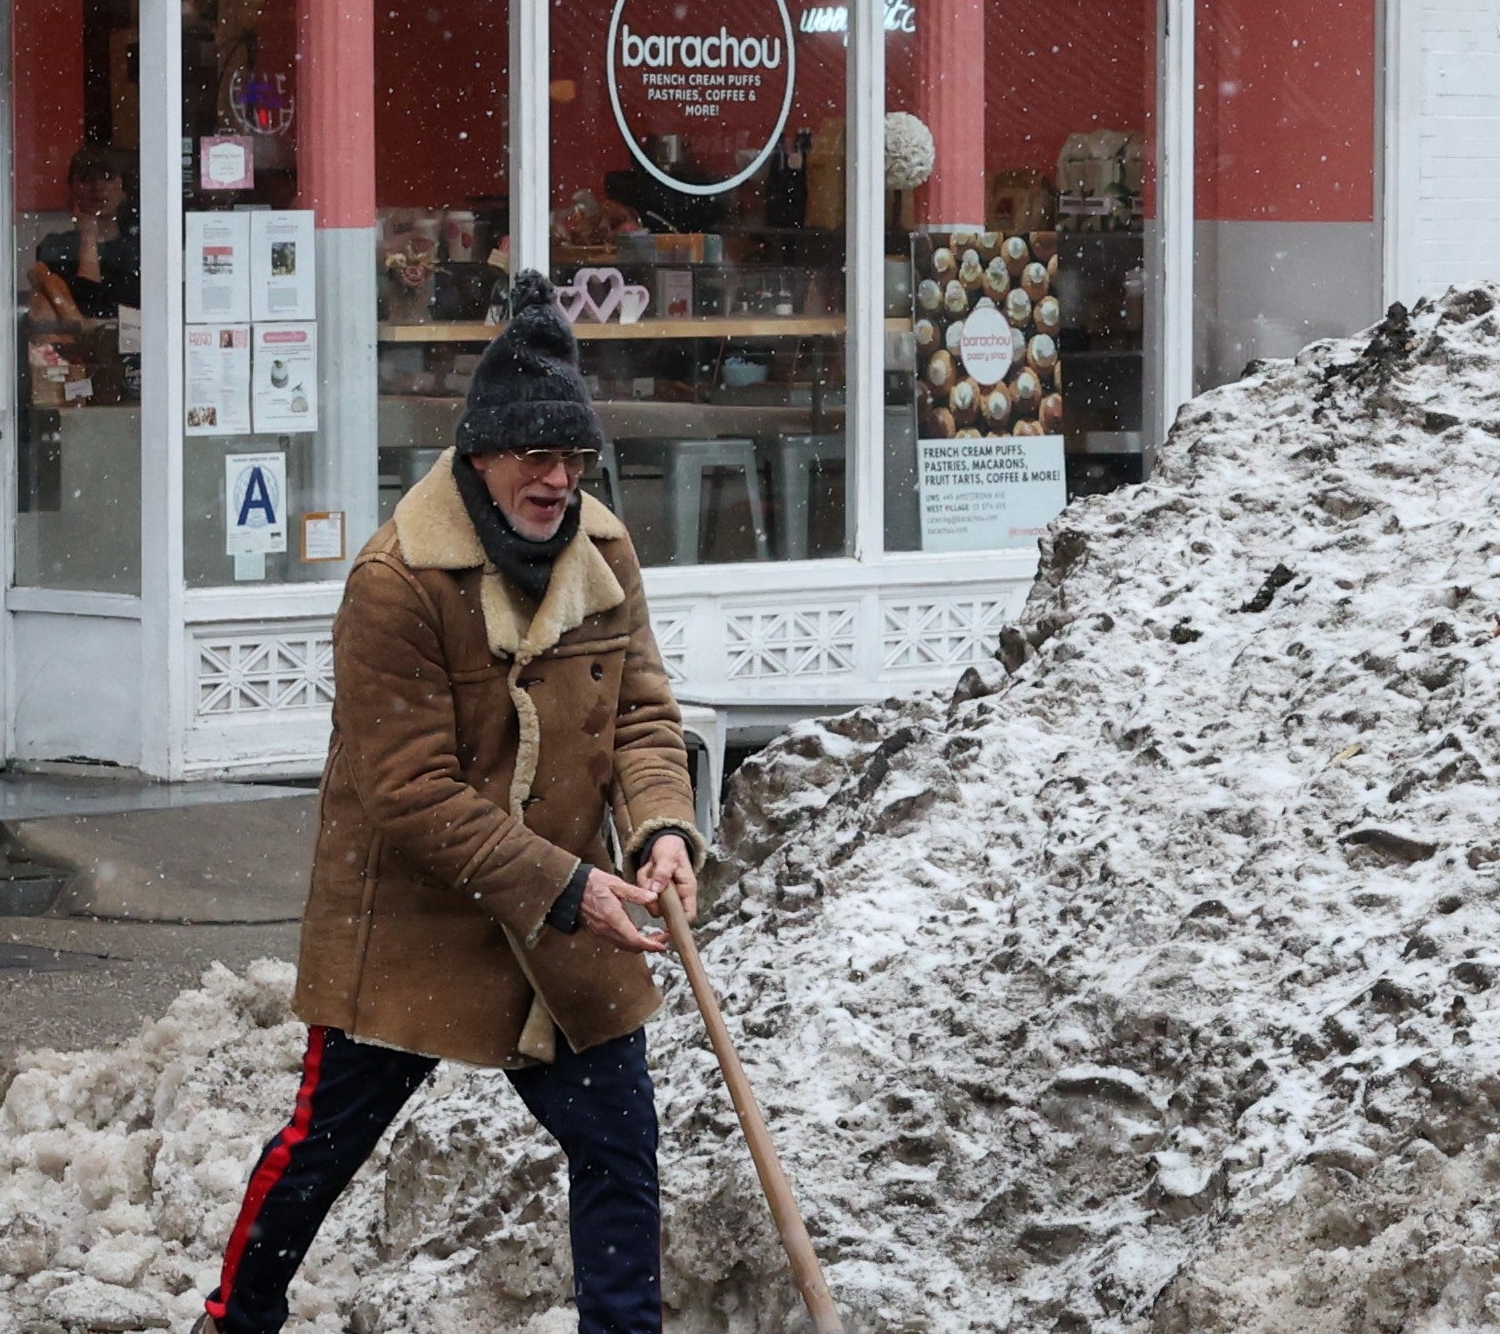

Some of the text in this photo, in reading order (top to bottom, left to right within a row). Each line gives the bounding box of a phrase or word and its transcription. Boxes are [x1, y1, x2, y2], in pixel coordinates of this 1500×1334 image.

[622, 24, 782, 69] barachou
[642, 73, 762, 86] FRENCH CREAM PUFFS
[705, 89, 745, 102] COFFEE
[748, 90, 757, 102] &
[685, 104, 720, 116] MORE!
[923, 444, 1026, 458] FRENCH CREAM PUFFS,
[924, 458, 1028, 472] PASTRIES, MACARONS,
[925, 470, 1061, 486] FRUIT TARTS, COFFEE & MORE!
[237, 466, 277, 526] A
